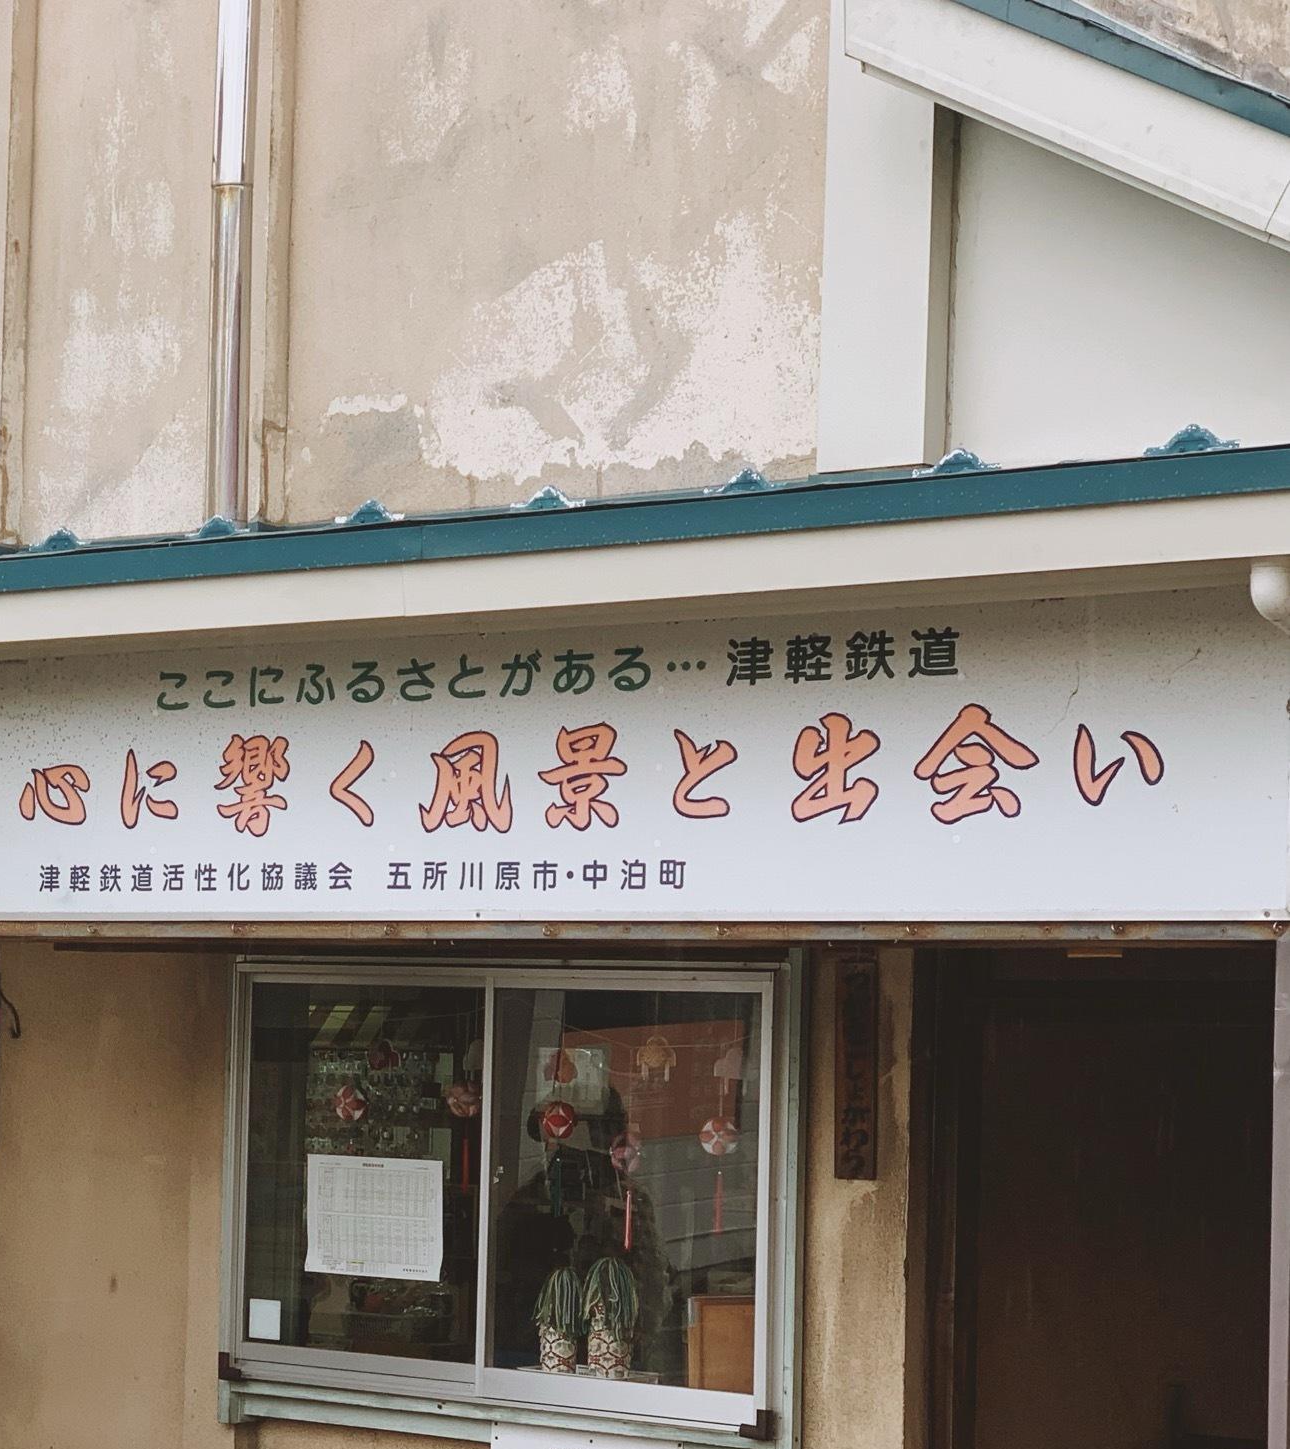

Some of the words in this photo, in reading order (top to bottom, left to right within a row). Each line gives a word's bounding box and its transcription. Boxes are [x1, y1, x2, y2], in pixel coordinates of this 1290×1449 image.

[724, 627, 962, 688] 津軽鉄道
[18, 702, 1168, 838] 心に響く風景と出会い
[37, 861, 355, 896] 津軽鉄道活性化協議会
[385, 857, 690, 895] 五所川原市・中泊町
